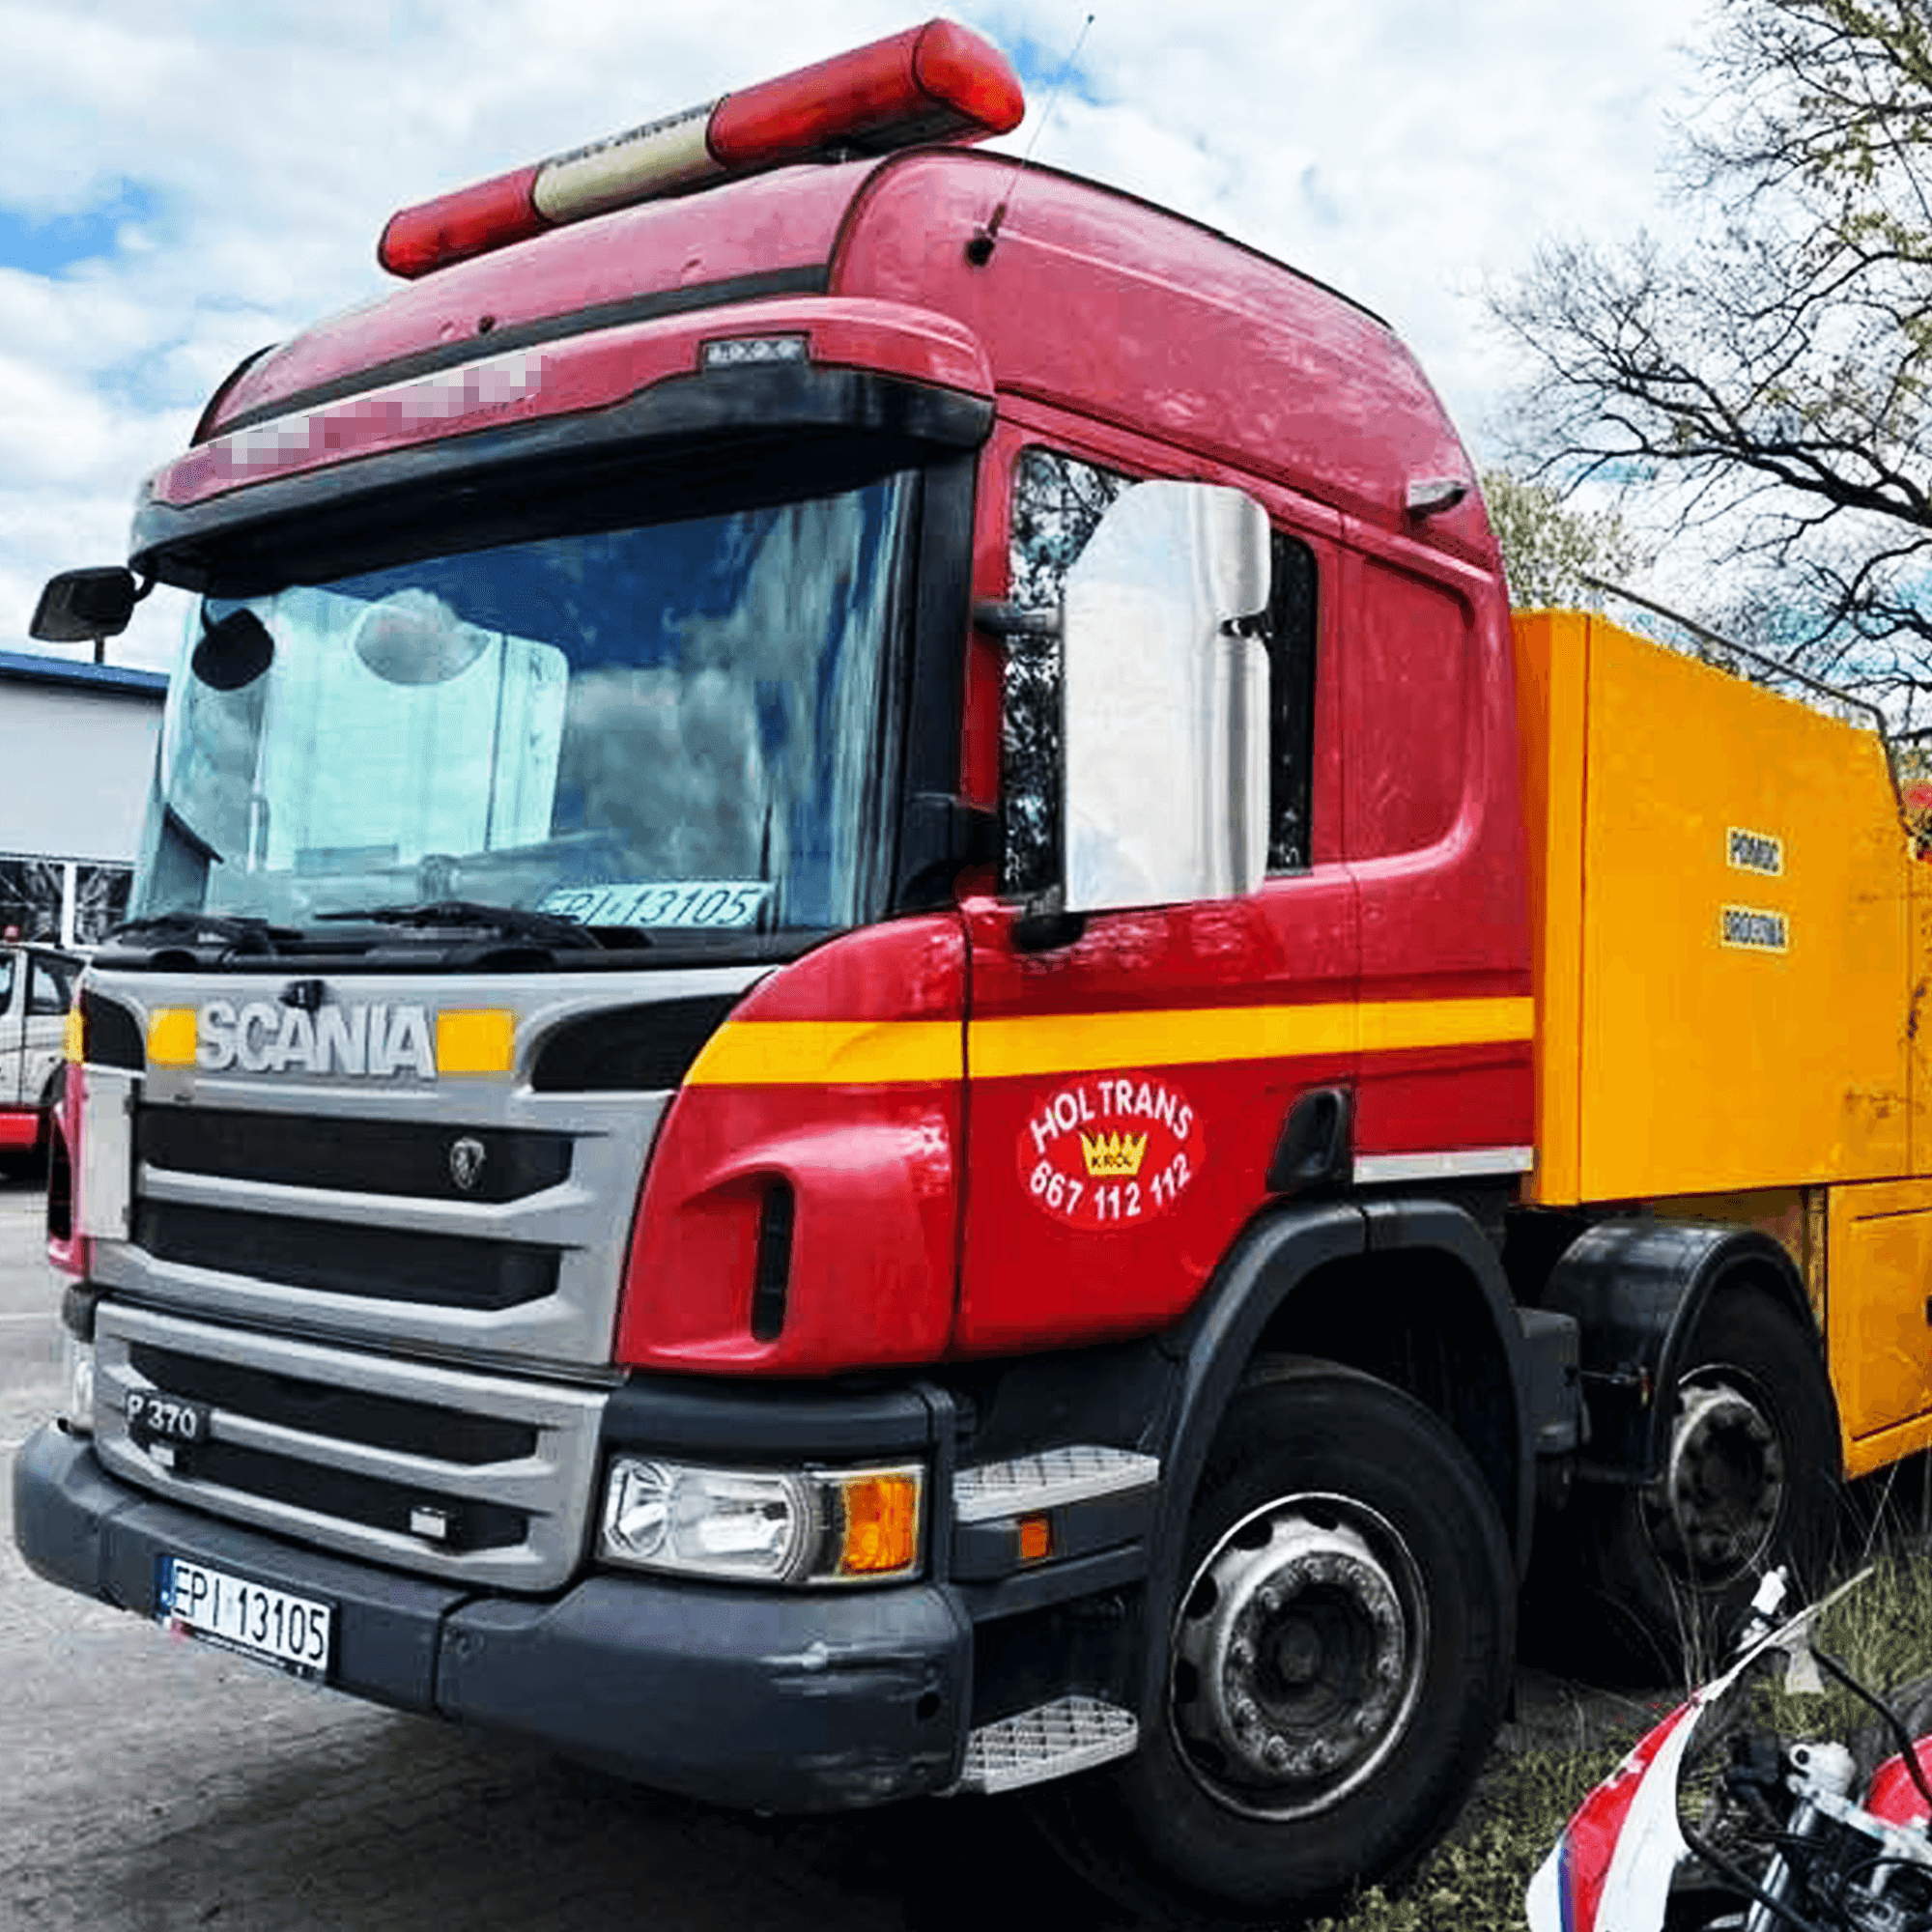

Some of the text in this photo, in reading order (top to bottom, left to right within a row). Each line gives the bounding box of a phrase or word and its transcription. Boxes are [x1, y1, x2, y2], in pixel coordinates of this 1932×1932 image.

[623, 889, 761, 924] 13105
[197, 999, 436, 1078] SCANIA
[1030, 1153, 1191, 1220] 667 112 112
[128, 1394, 197, 1438] P 370
[175, 1565, 326, 1662] EPI 13105
